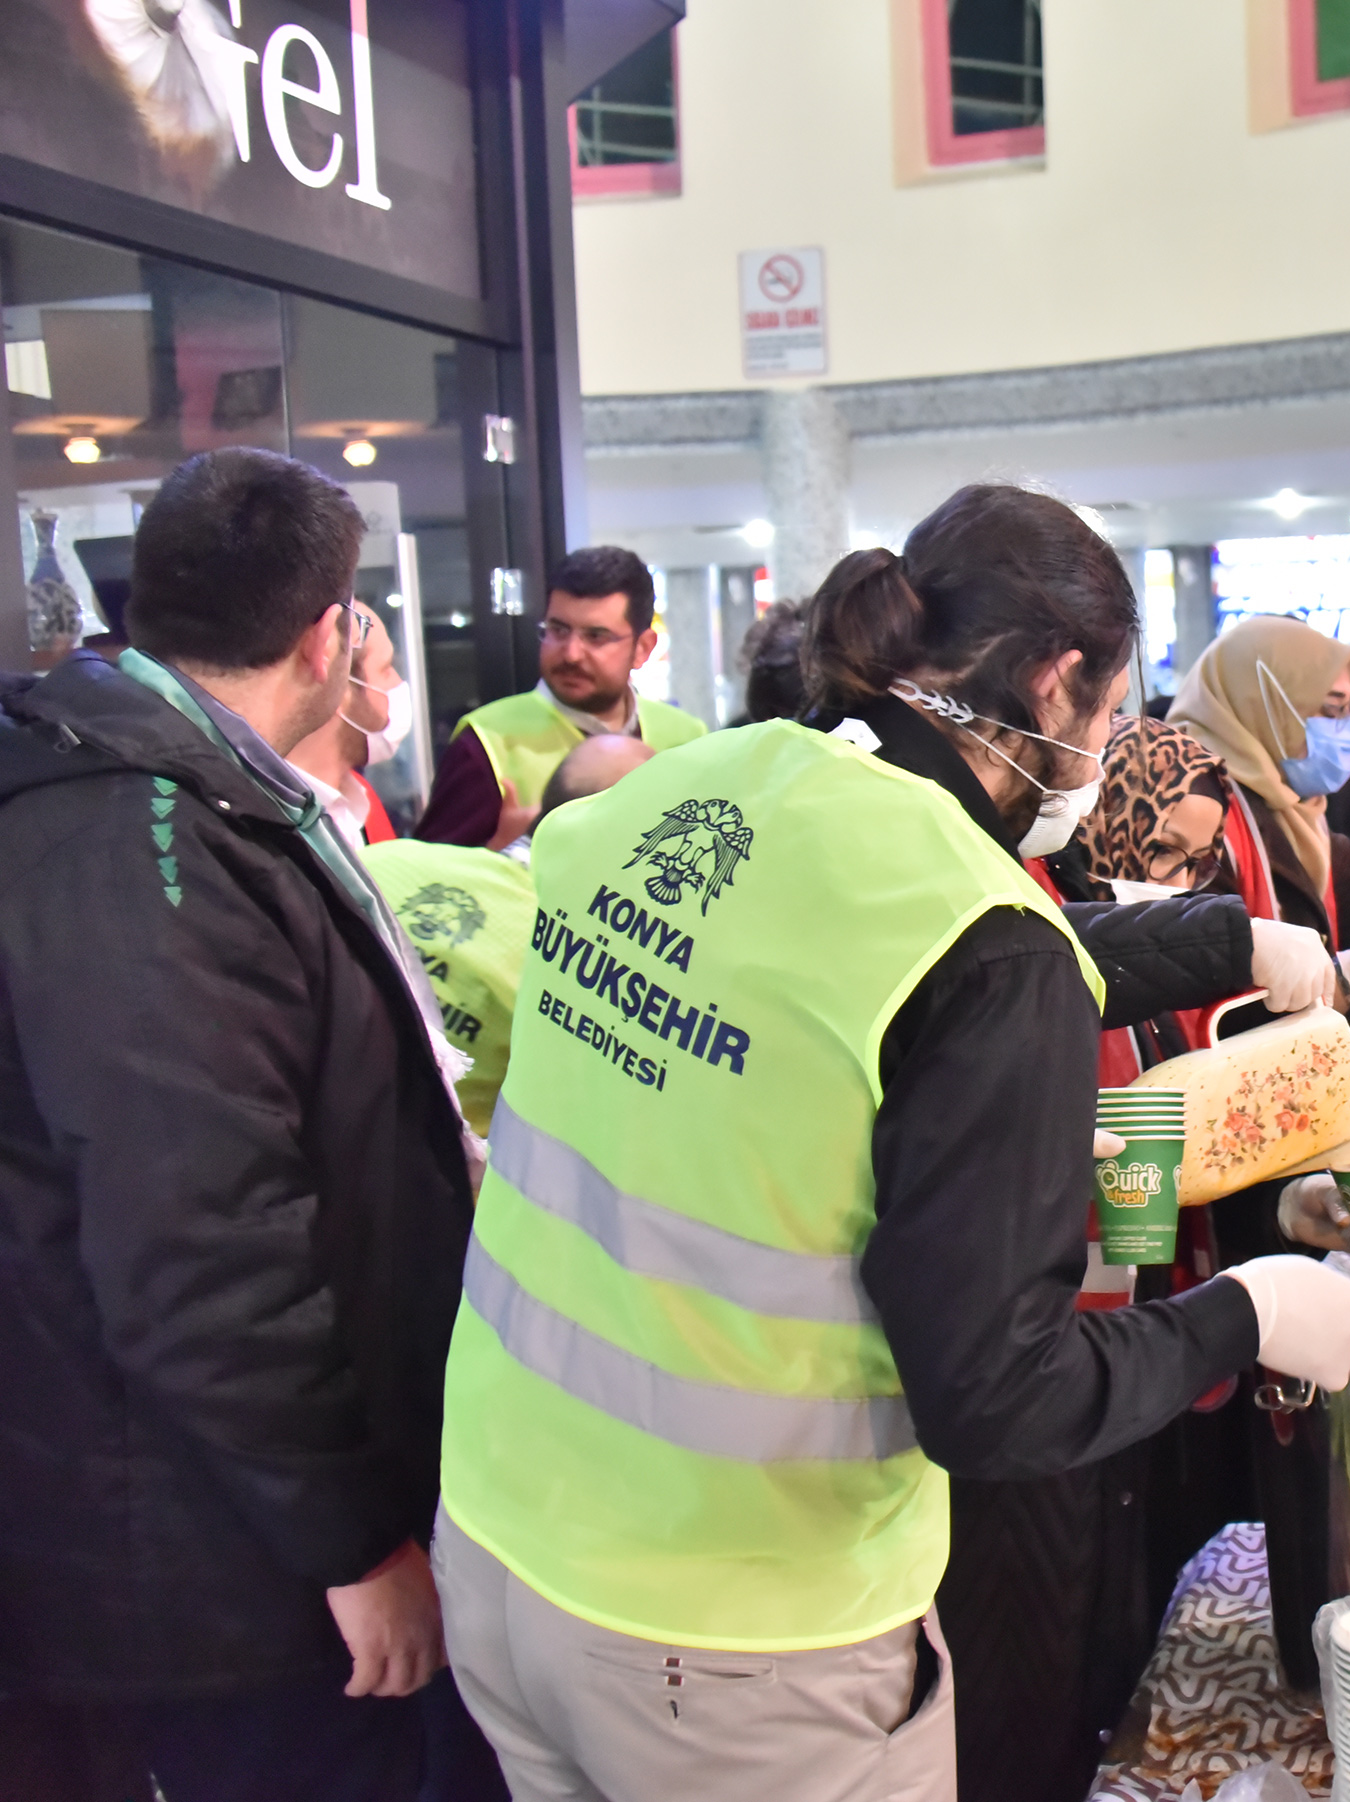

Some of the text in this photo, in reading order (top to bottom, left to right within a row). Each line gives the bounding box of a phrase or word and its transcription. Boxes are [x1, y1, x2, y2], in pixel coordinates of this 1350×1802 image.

[586, 884, 695, 974] KONYA
[531, 906, 751, 1076] BÜYÜKŞEHİR
[537, 988, 668, 1092] BELEDİYESİ
[1098, 1164, 1160, 1192] Quick
